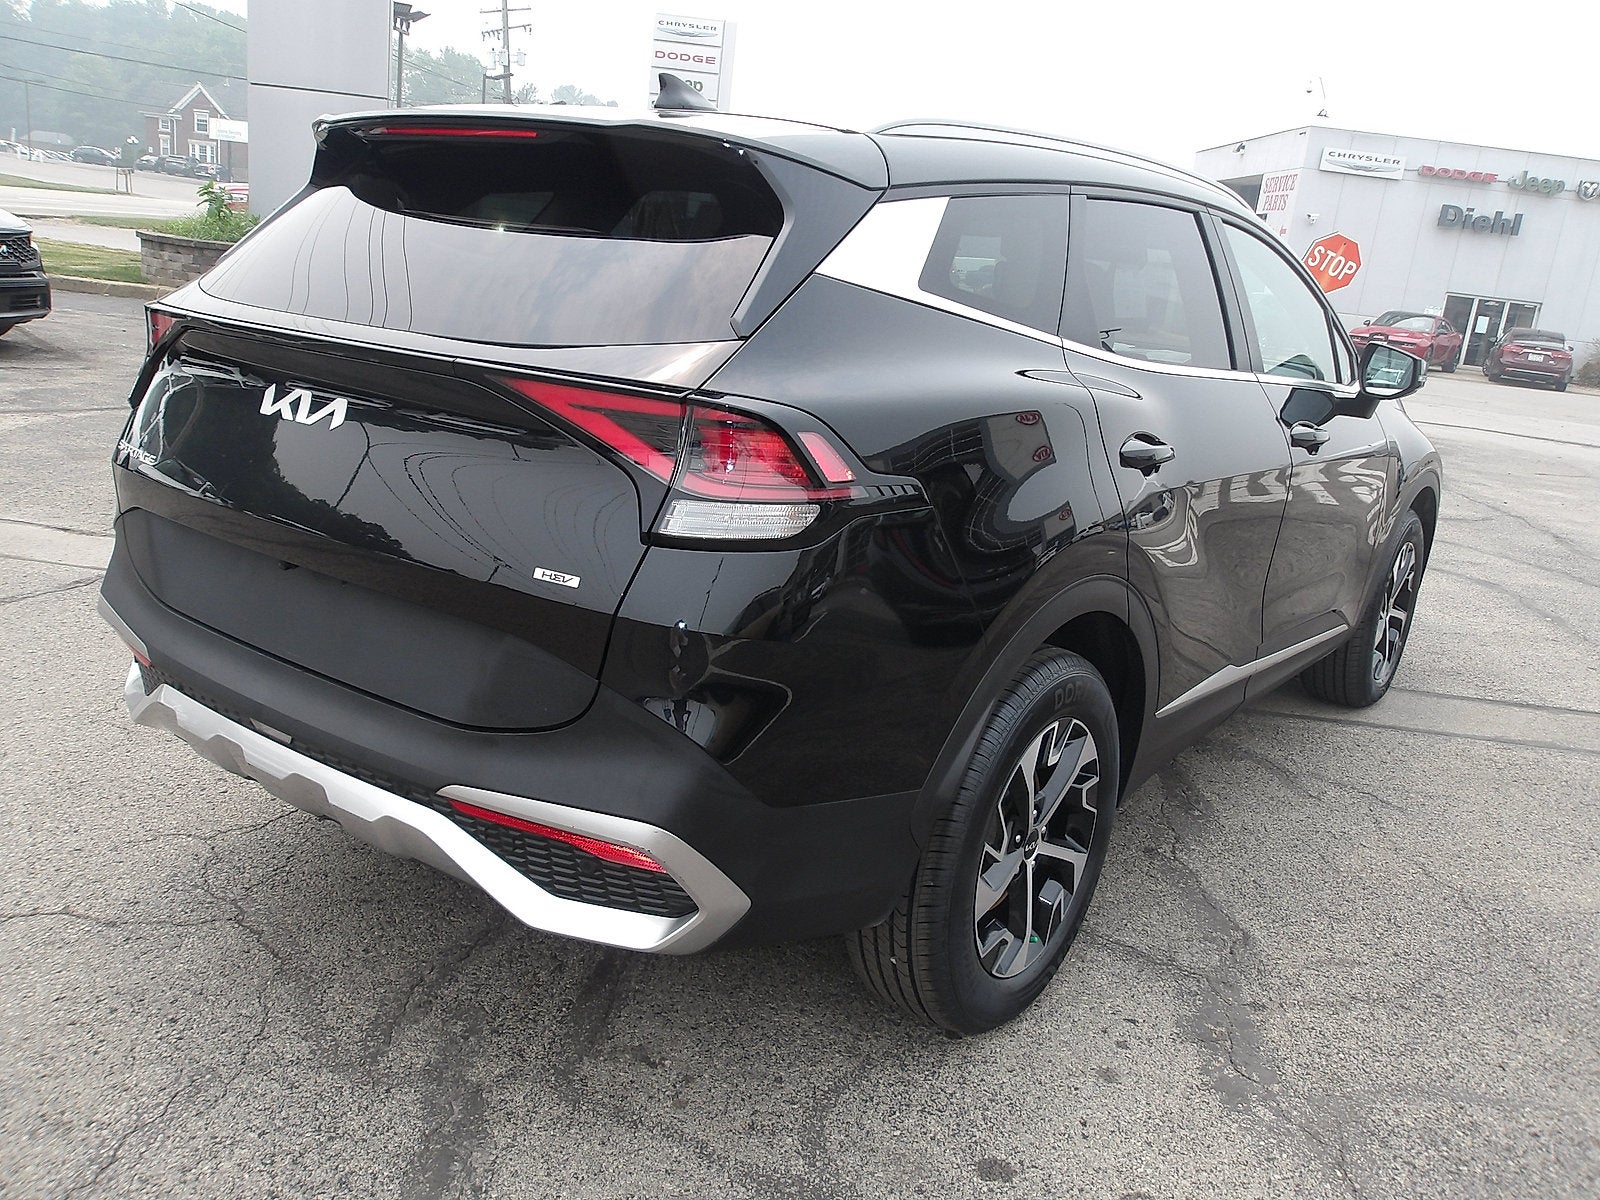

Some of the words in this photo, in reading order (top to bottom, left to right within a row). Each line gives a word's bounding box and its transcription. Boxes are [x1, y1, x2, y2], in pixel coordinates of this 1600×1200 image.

[658, 20, 717, 31] CHRYSLER
[655, 50, 716, 65] DODGE
[1328, 151, 1401, 165] CHRYSLER
[1263, 173, 1298, 194] SERVICE
[1418, 165, 1498, 184] DODGE
[1508, 170, 1565, 195] Jeep
[1262, 194, 1289, 211] PARTS
[1438, 204, 1524, 236] Diehl
[1308, 245, 1357, 280] STOP
[260, 383, 348, 431] KIA
[541, 571, 574, 583] HEV
